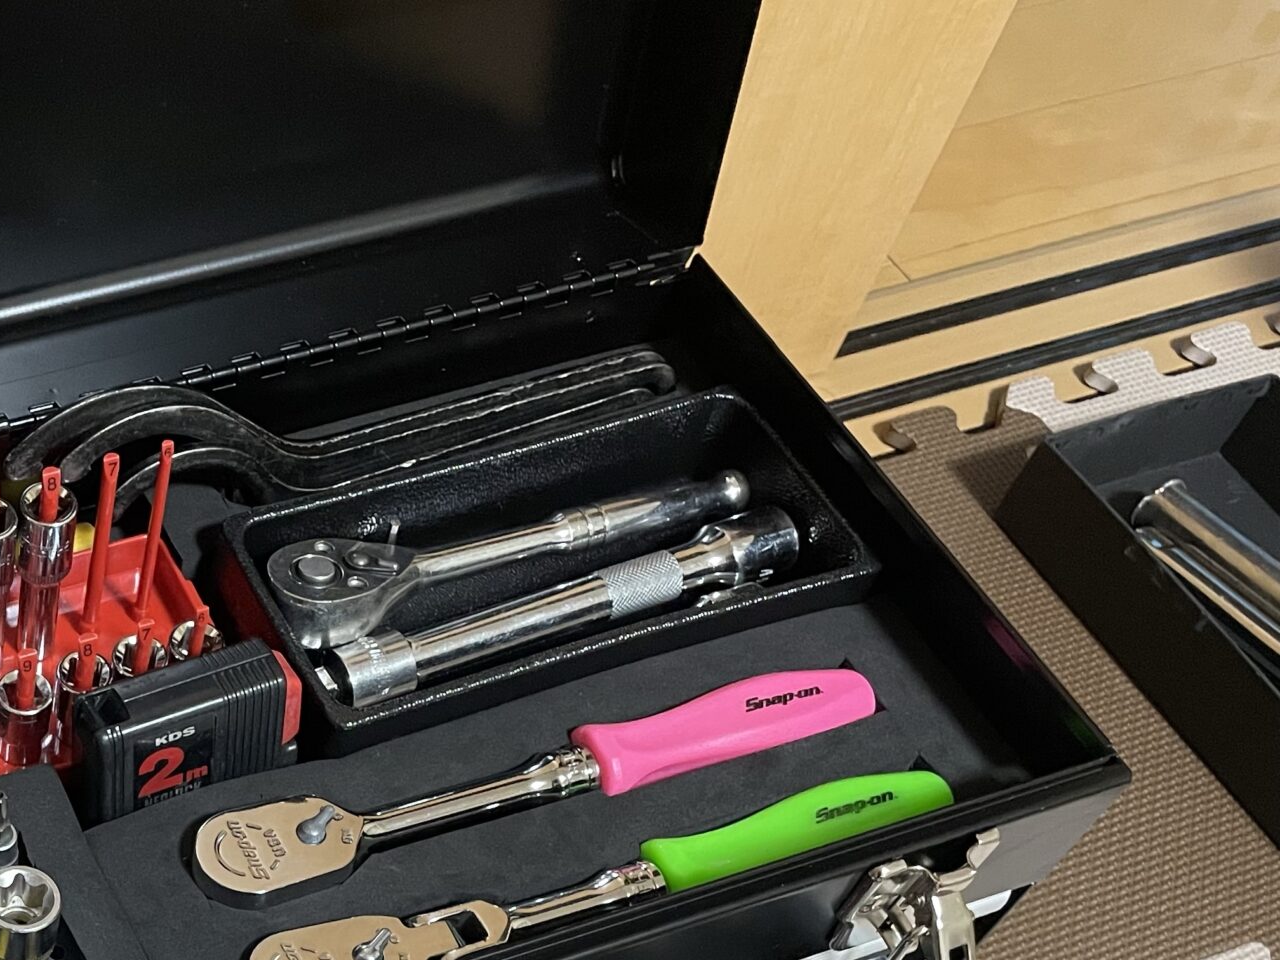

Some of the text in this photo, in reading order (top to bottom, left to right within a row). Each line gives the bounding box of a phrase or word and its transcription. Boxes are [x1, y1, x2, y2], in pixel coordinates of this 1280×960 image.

[108, 461, 118, 476] 7
[47, 477, 57, 491] 8
[141, 627, 151, 641] 7
[83, 643, 93, 656] 8
[22, 659, 32, 672] 9
[745, 686, 823, 712] Snap-on
[154, 725, 196, 747] KDS
[816, 791, 894, 824] Snap-on
[227, 820, 270, 880] Snap-on
[263, 828, 287, 858] USA
